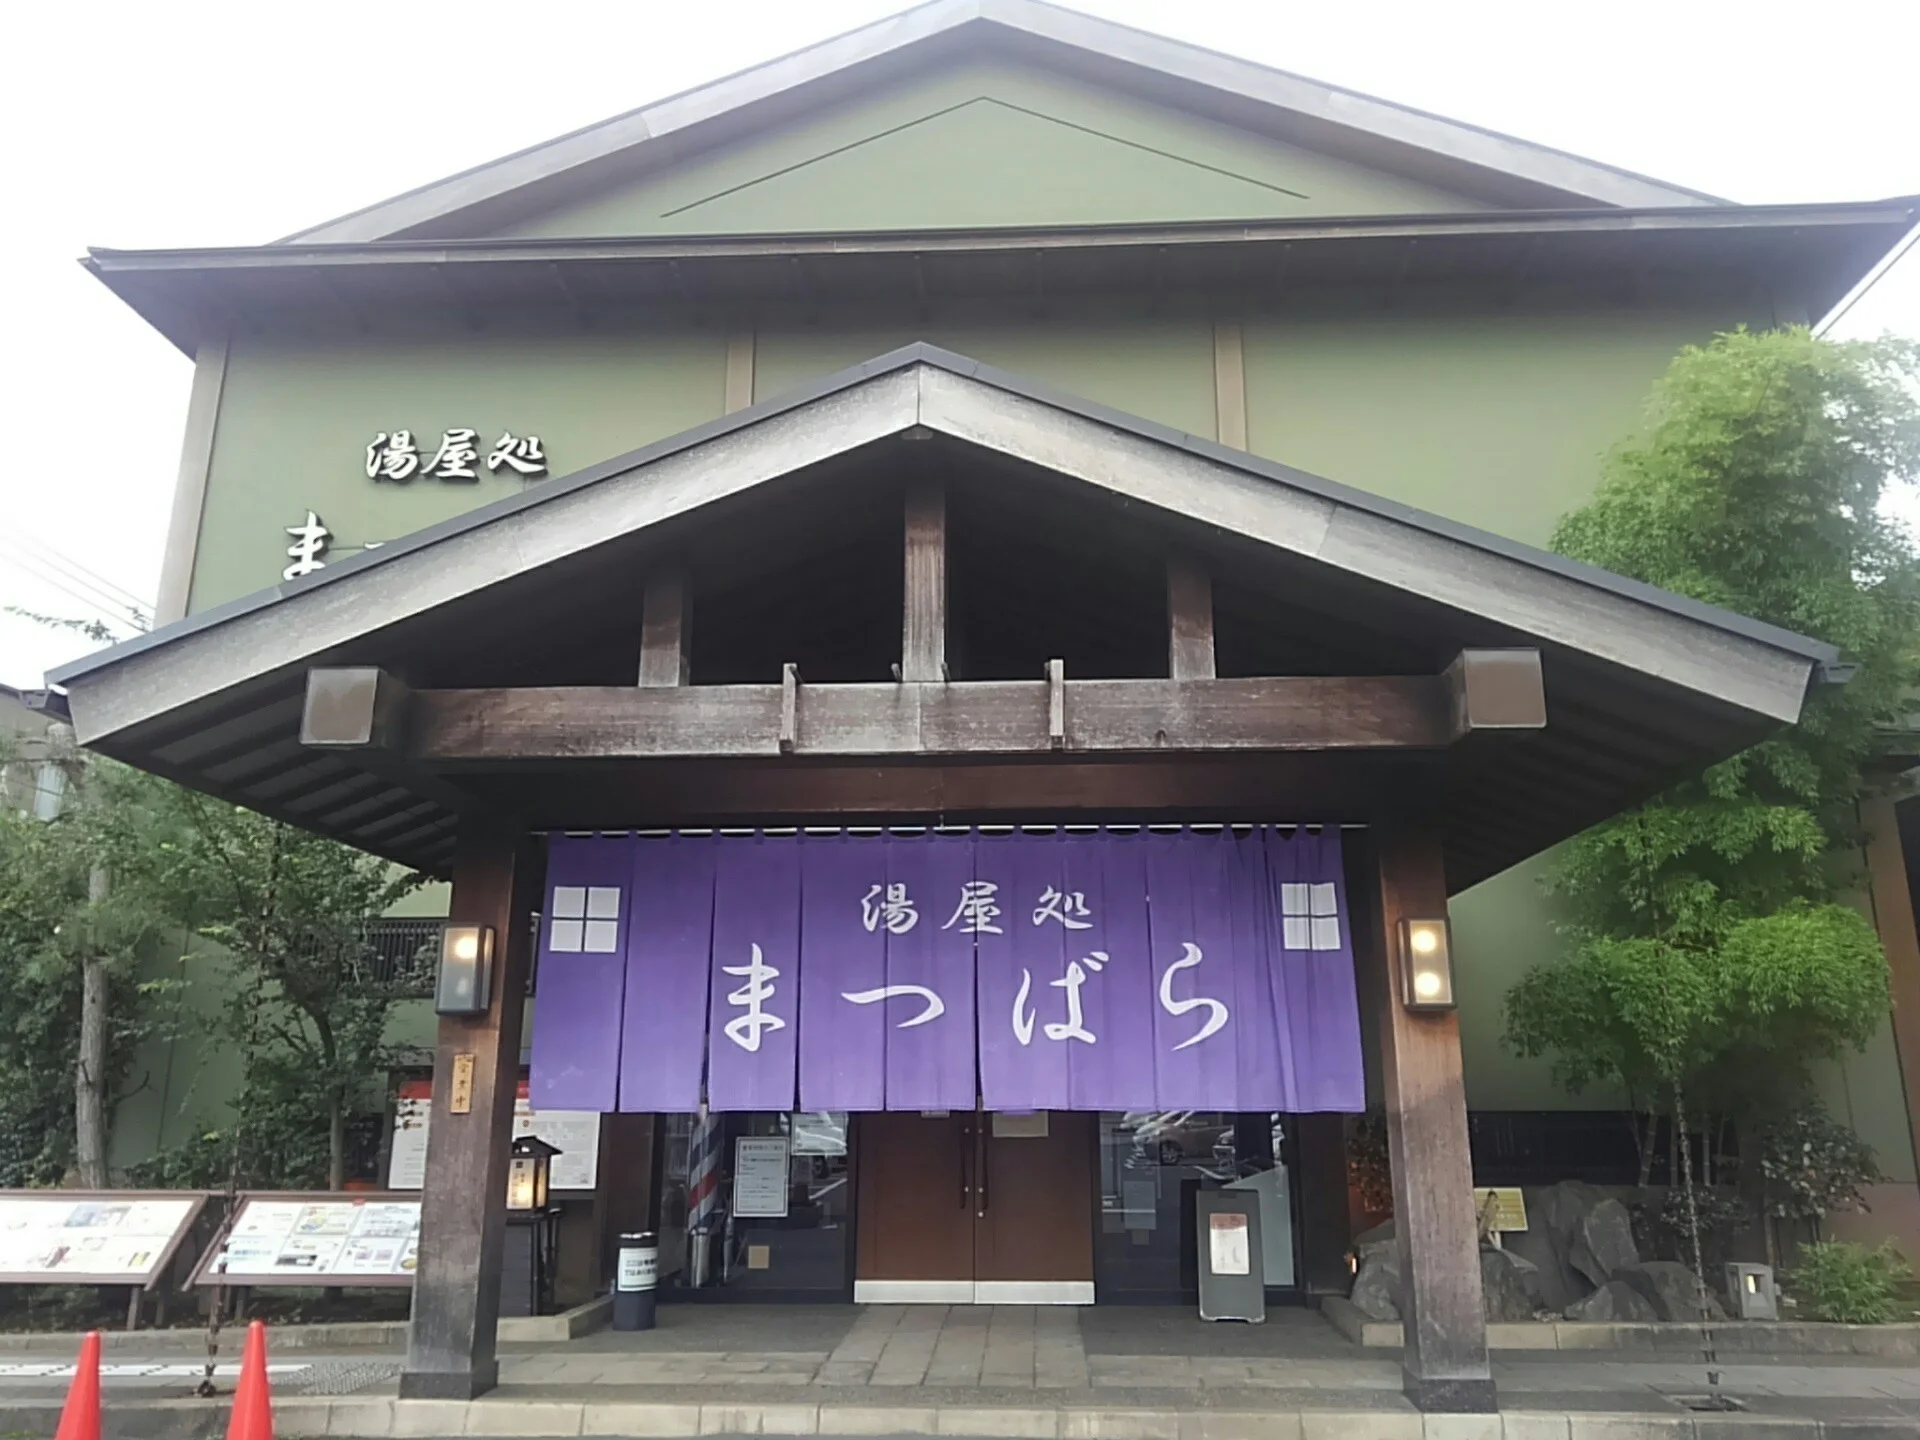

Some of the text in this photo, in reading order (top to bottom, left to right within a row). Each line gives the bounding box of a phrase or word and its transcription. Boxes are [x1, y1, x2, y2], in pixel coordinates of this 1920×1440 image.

[365, 428, 547, 479] 湯屋処
[861, 881, 1094, 934] 湯屋処
[721, 942, 1229, 1052] まつばら
